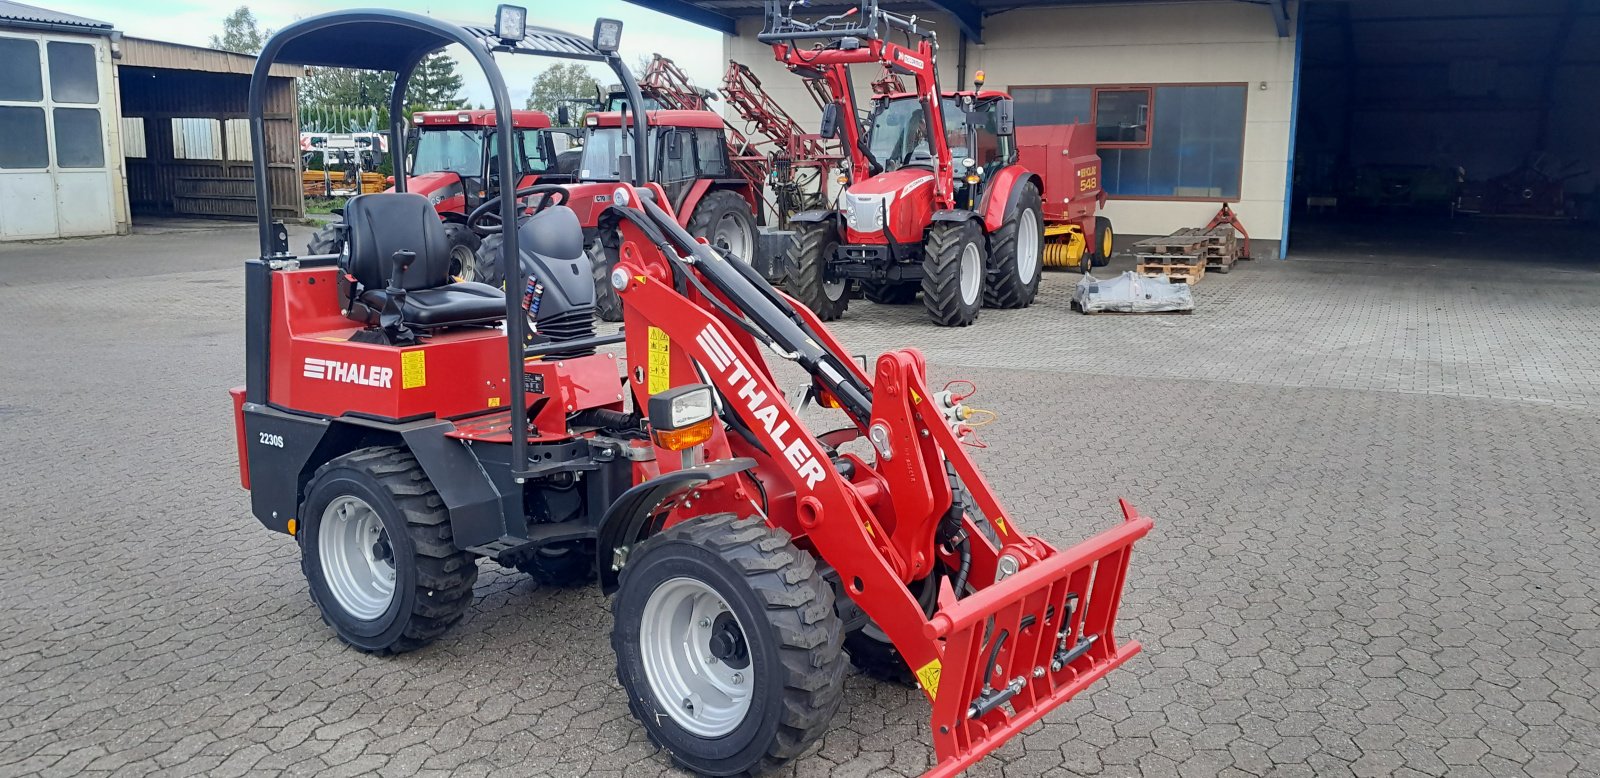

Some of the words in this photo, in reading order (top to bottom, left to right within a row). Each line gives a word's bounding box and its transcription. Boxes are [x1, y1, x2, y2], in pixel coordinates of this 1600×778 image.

[1080, 177, 1097, 192] 548
[325, 360, 393, 389] THALER
[727, 358, 826, 491] THALER
[259, 432, 284, 448] 2230S
